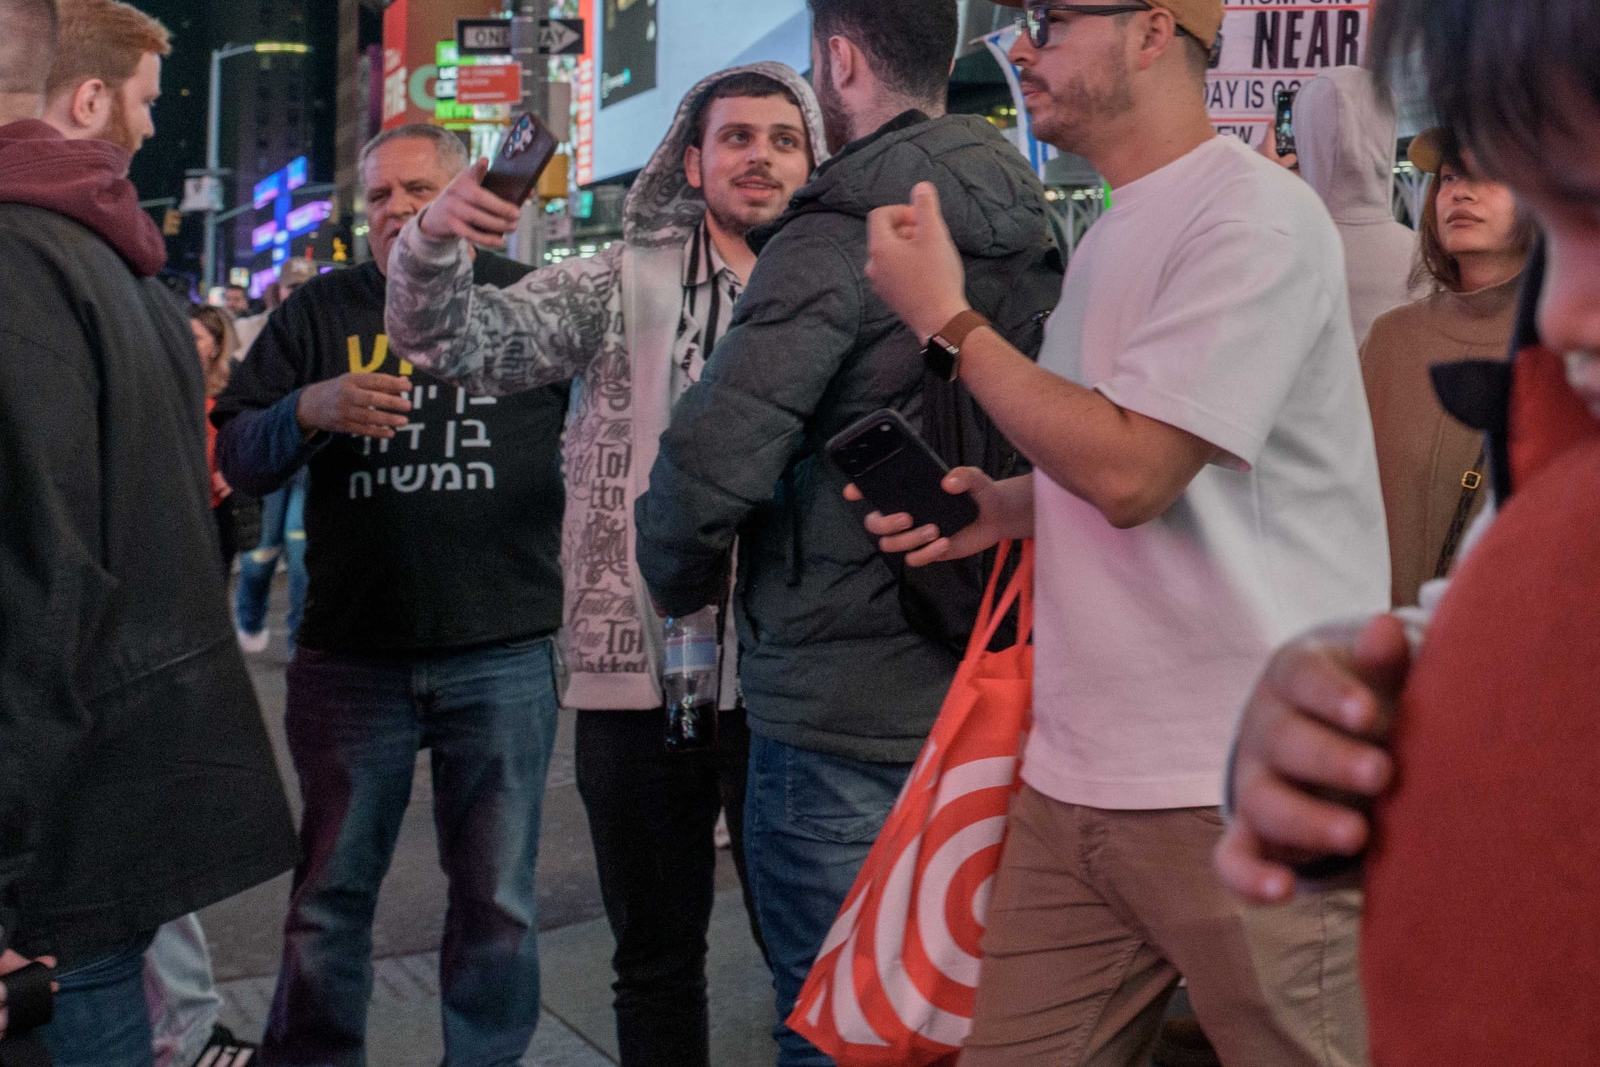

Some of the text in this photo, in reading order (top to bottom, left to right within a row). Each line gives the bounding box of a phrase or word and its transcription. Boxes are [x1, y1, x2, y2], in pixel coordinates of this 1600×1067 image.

[1253, 10, 1361, 70] NEAR
[1244, 80, 1265, 109] IS
[350, 462, 496, 500] המשיח
